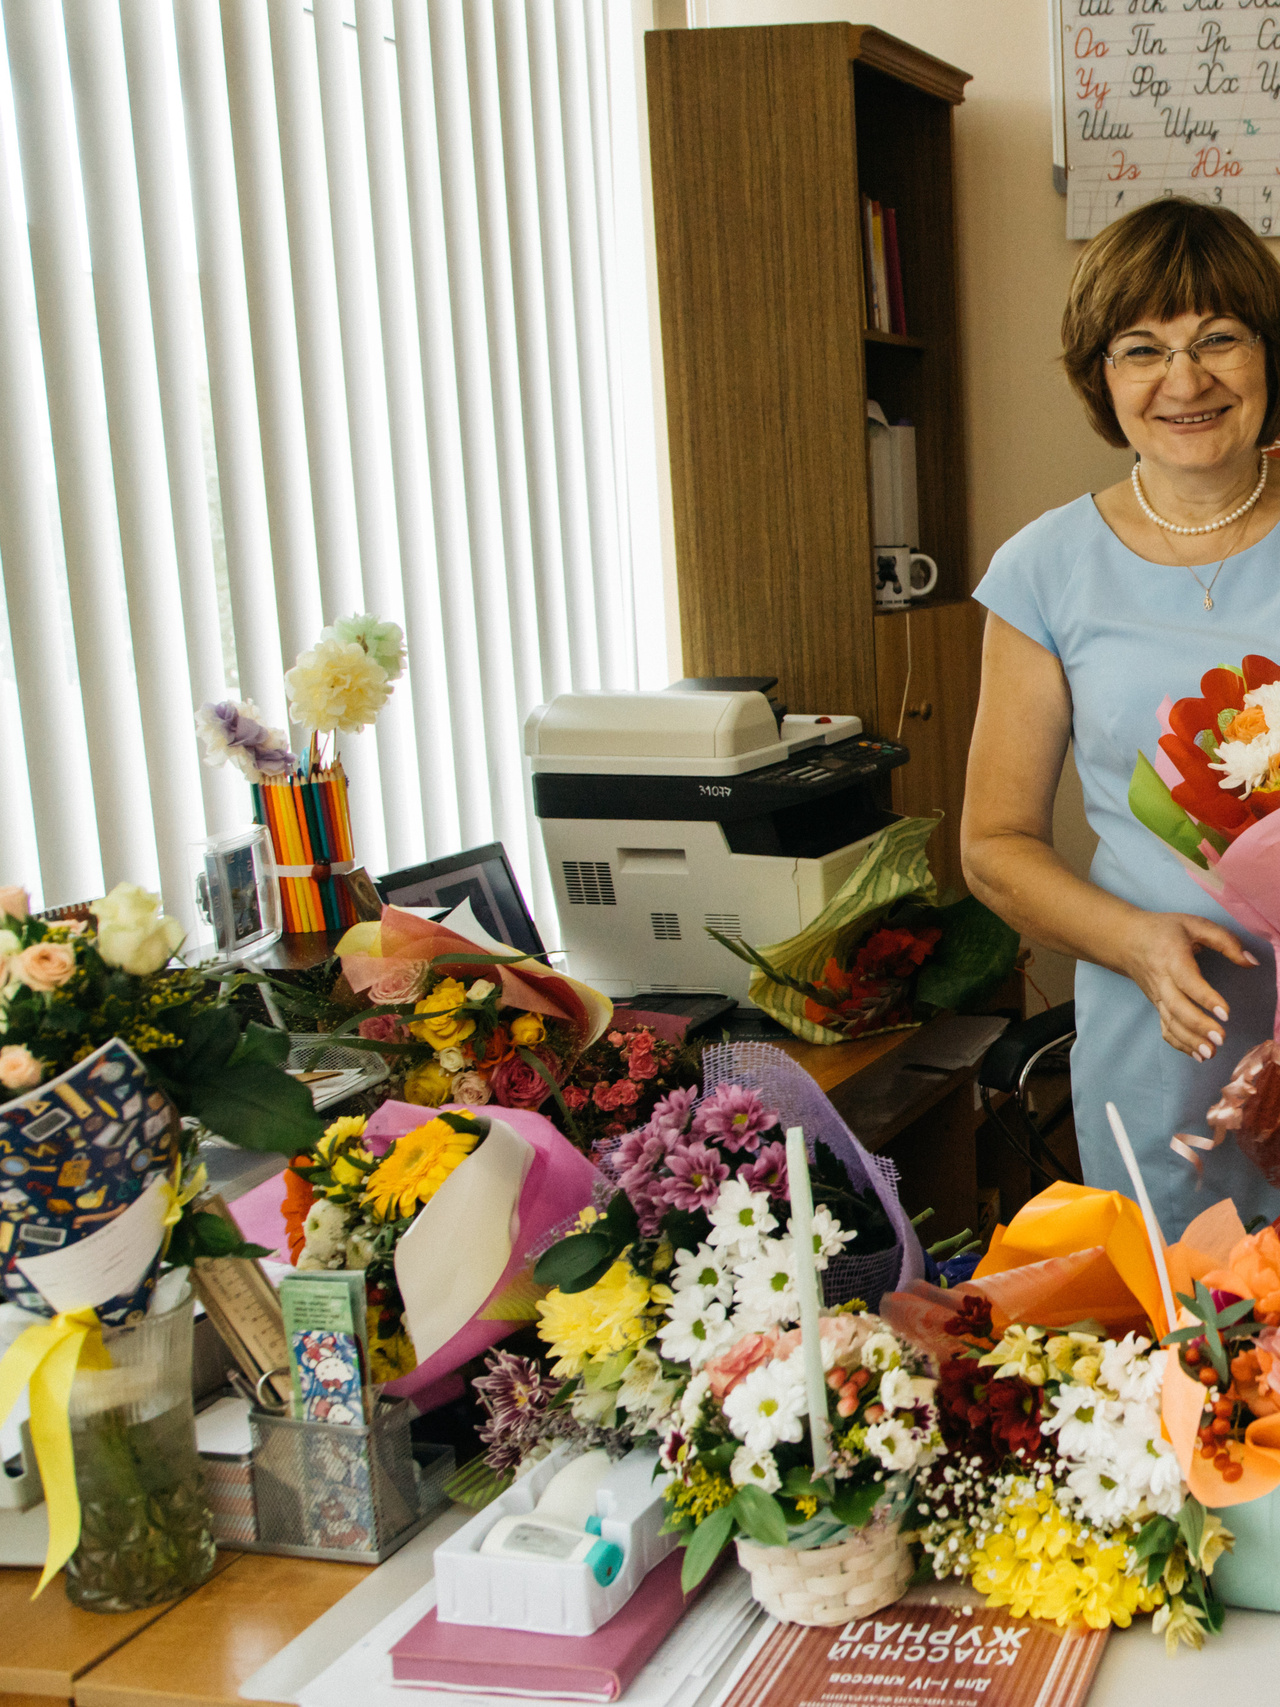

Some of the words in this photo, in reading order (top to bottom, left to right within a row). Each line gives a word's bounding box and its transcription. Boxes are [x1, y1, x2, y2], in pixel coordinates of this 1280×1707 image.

[1075, 27, 1109, 58] Оо
[1127, 23, 1167, 55] Пп
[1197, 20, 1231, 63] Рр
[1076, 67, 1111, 110] Уу
[1130, 65, 1170, 107] Фф
[1194, 62, 1239, 94] Хх
[1078, 109, 1133, 140] Шш
[1161, 107, 1219, 144] Щщ
[1107, 149, 1141, 181] Ээ
[1191, 147, 1243, 177] Юю
[1262, 185, 1272, 203] 4
[1261, 217, 1272, 234] 9
[838, 1620, 1031, 1648] ЖУРНАЛ
[827, 1642, 1019, 1666] КЛАССНЫЙ
[829, 1672, 906, 1686] классов
[953, 1677, 992, 1692] Для
